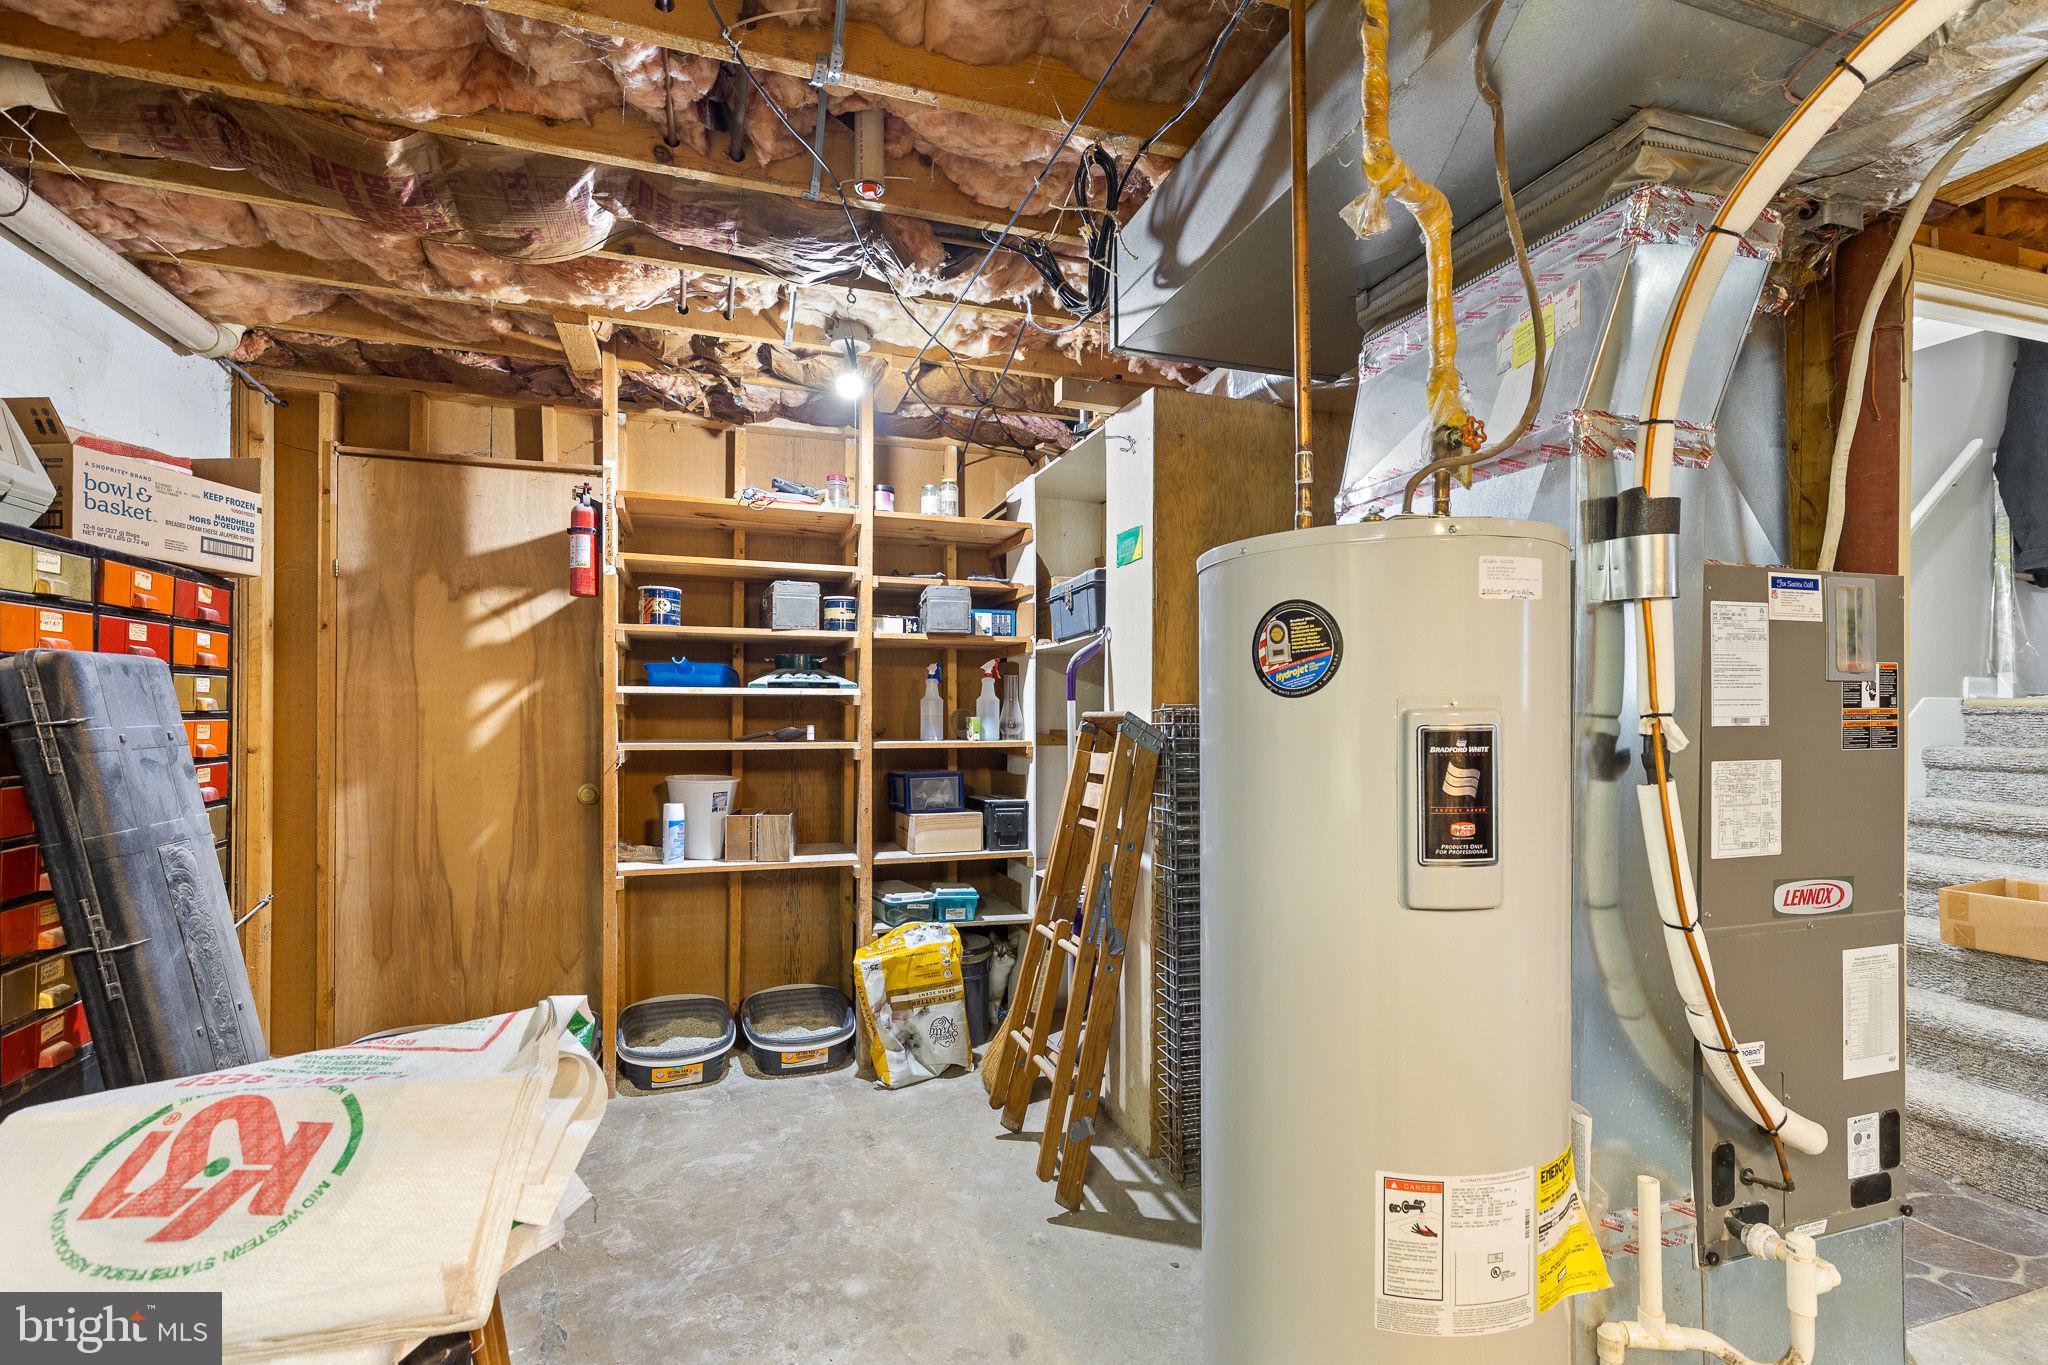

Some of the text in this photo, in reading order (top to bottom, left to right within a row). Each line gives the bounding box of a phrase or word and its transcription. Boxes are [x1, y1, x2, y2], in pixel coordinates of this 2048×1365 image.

[130, 473, 152, 481] BRAND
[84, 472, 132, 499] bowl
[136, 487, 152, 502] &
[83, 491, 152, 522] basket
[203, 491, 255, 510] KEEP FROZEN
[189, 514, 255, 535] HORS D'OEUVRES
[215, 514, 255, 528] HANDHELD
[165, 520, 186, 529] BREADED
[187, 524, 202, 532] CREAM
[203, 527, 218, 536] CHEESE
[240, 535, 255, 543] PEPPER
[1275, 665, 1309, 682] Hydrojet
[1783, 887, 1833, 907] LENNOX
[911, 994, 956, 1007] CLAY LITTER
[918, 987, 956, 998] FRESH SCENT
[174, 1073, 274, 1088] SEED
[77, 1094, 334, 1243] K31
[303, 1180, 331, 1209] MID
[1404, 1183, 1438, 1192] DANGER
[223, 1208, 304, 1263] WESTERN
[91, 1264, 148, 1281] FESCUE
[149, 1257, 216, 1281] STATES
